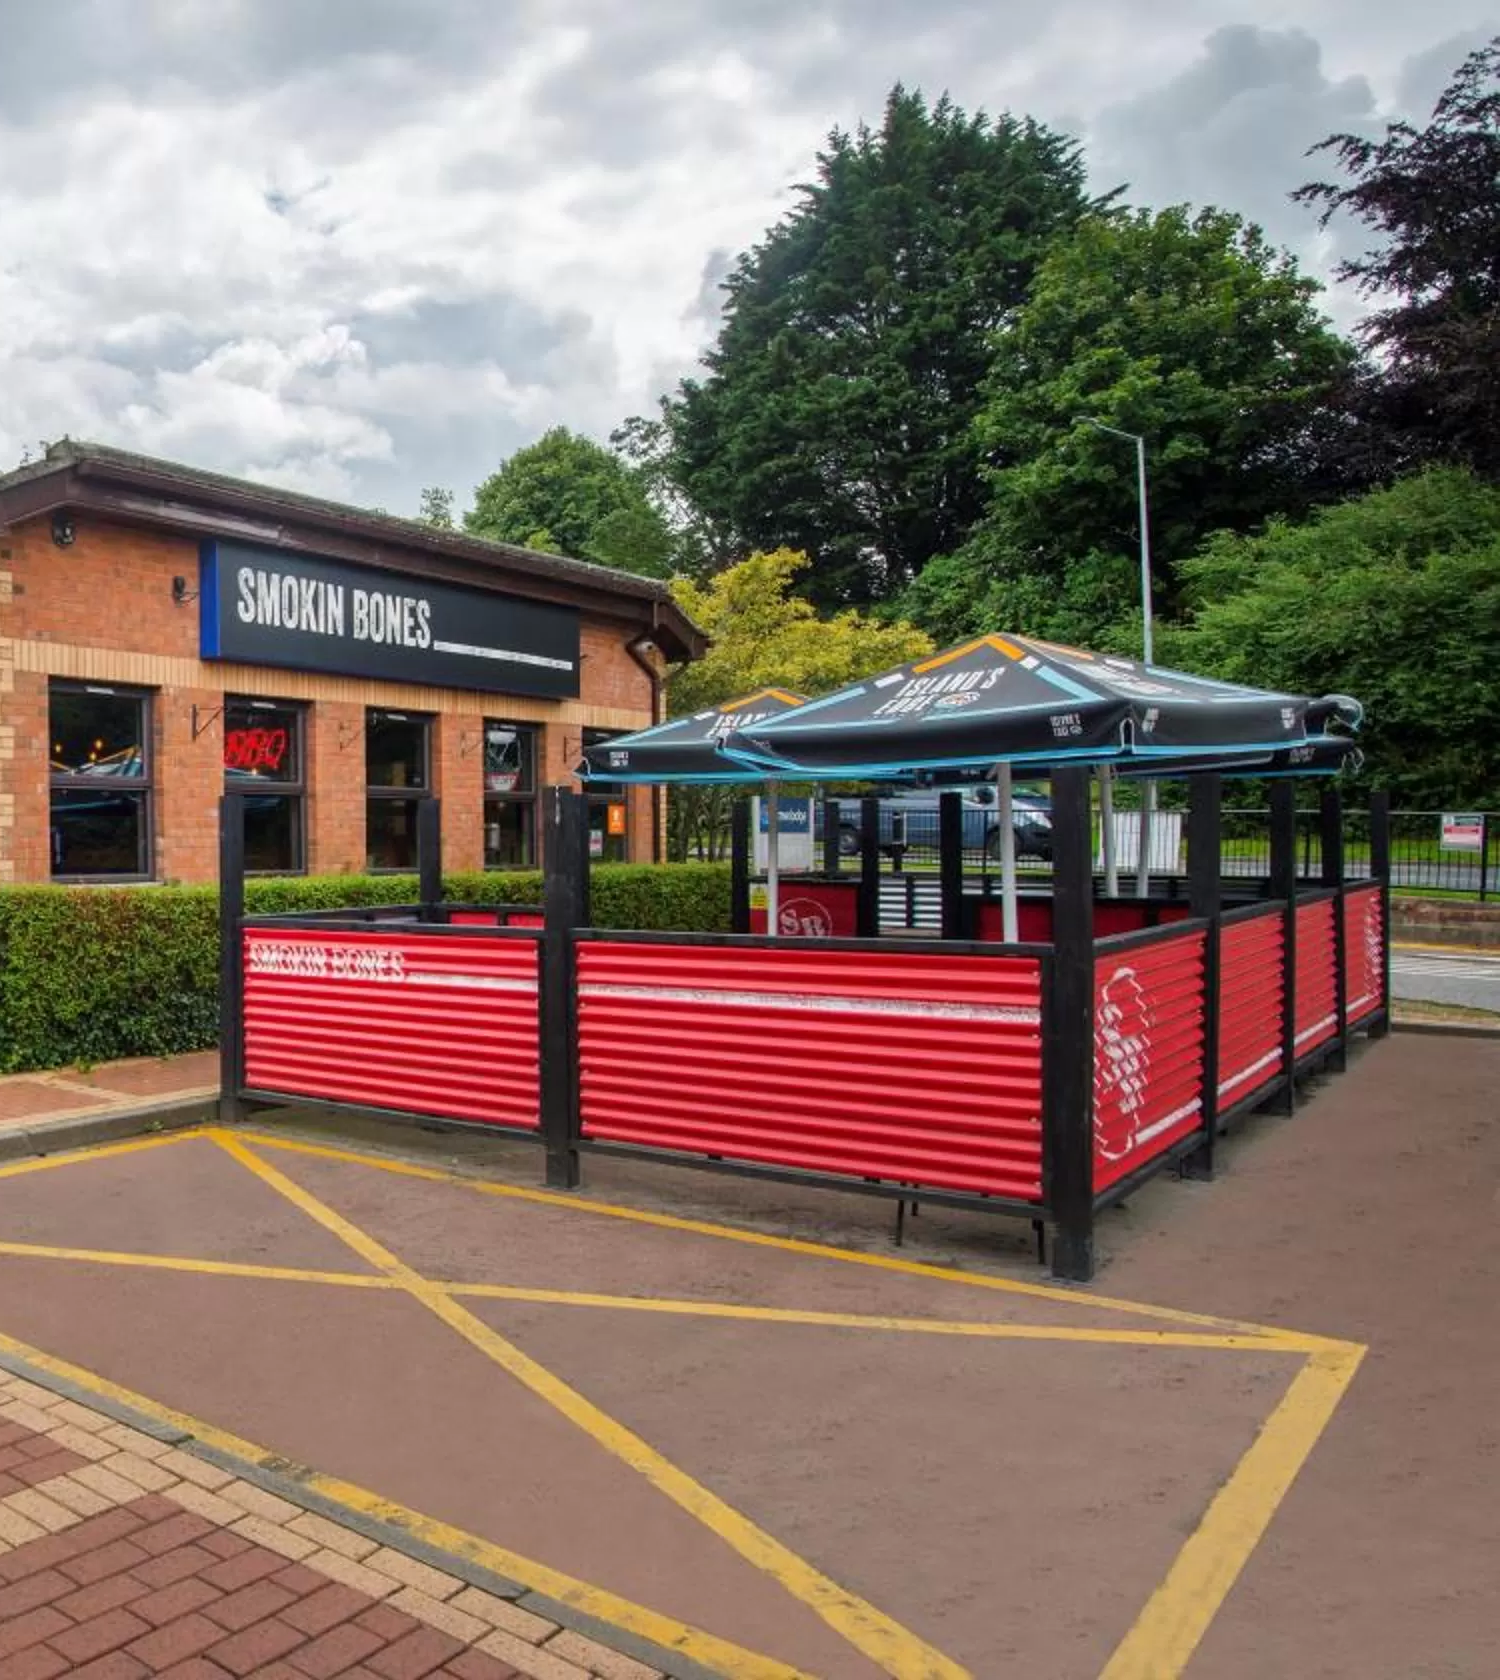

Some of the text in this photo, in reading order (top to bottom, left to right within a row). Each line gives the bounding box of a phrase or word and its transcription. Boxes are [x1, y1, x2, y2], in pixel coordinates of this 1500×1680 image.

[237, 567, 432, 650] SMOKIN BONES
[895, 666, 1006, 699] ISLAND'S
[224, 728, 285, 769] BBQ
[250, 944, 325, 976] SMOKIN
